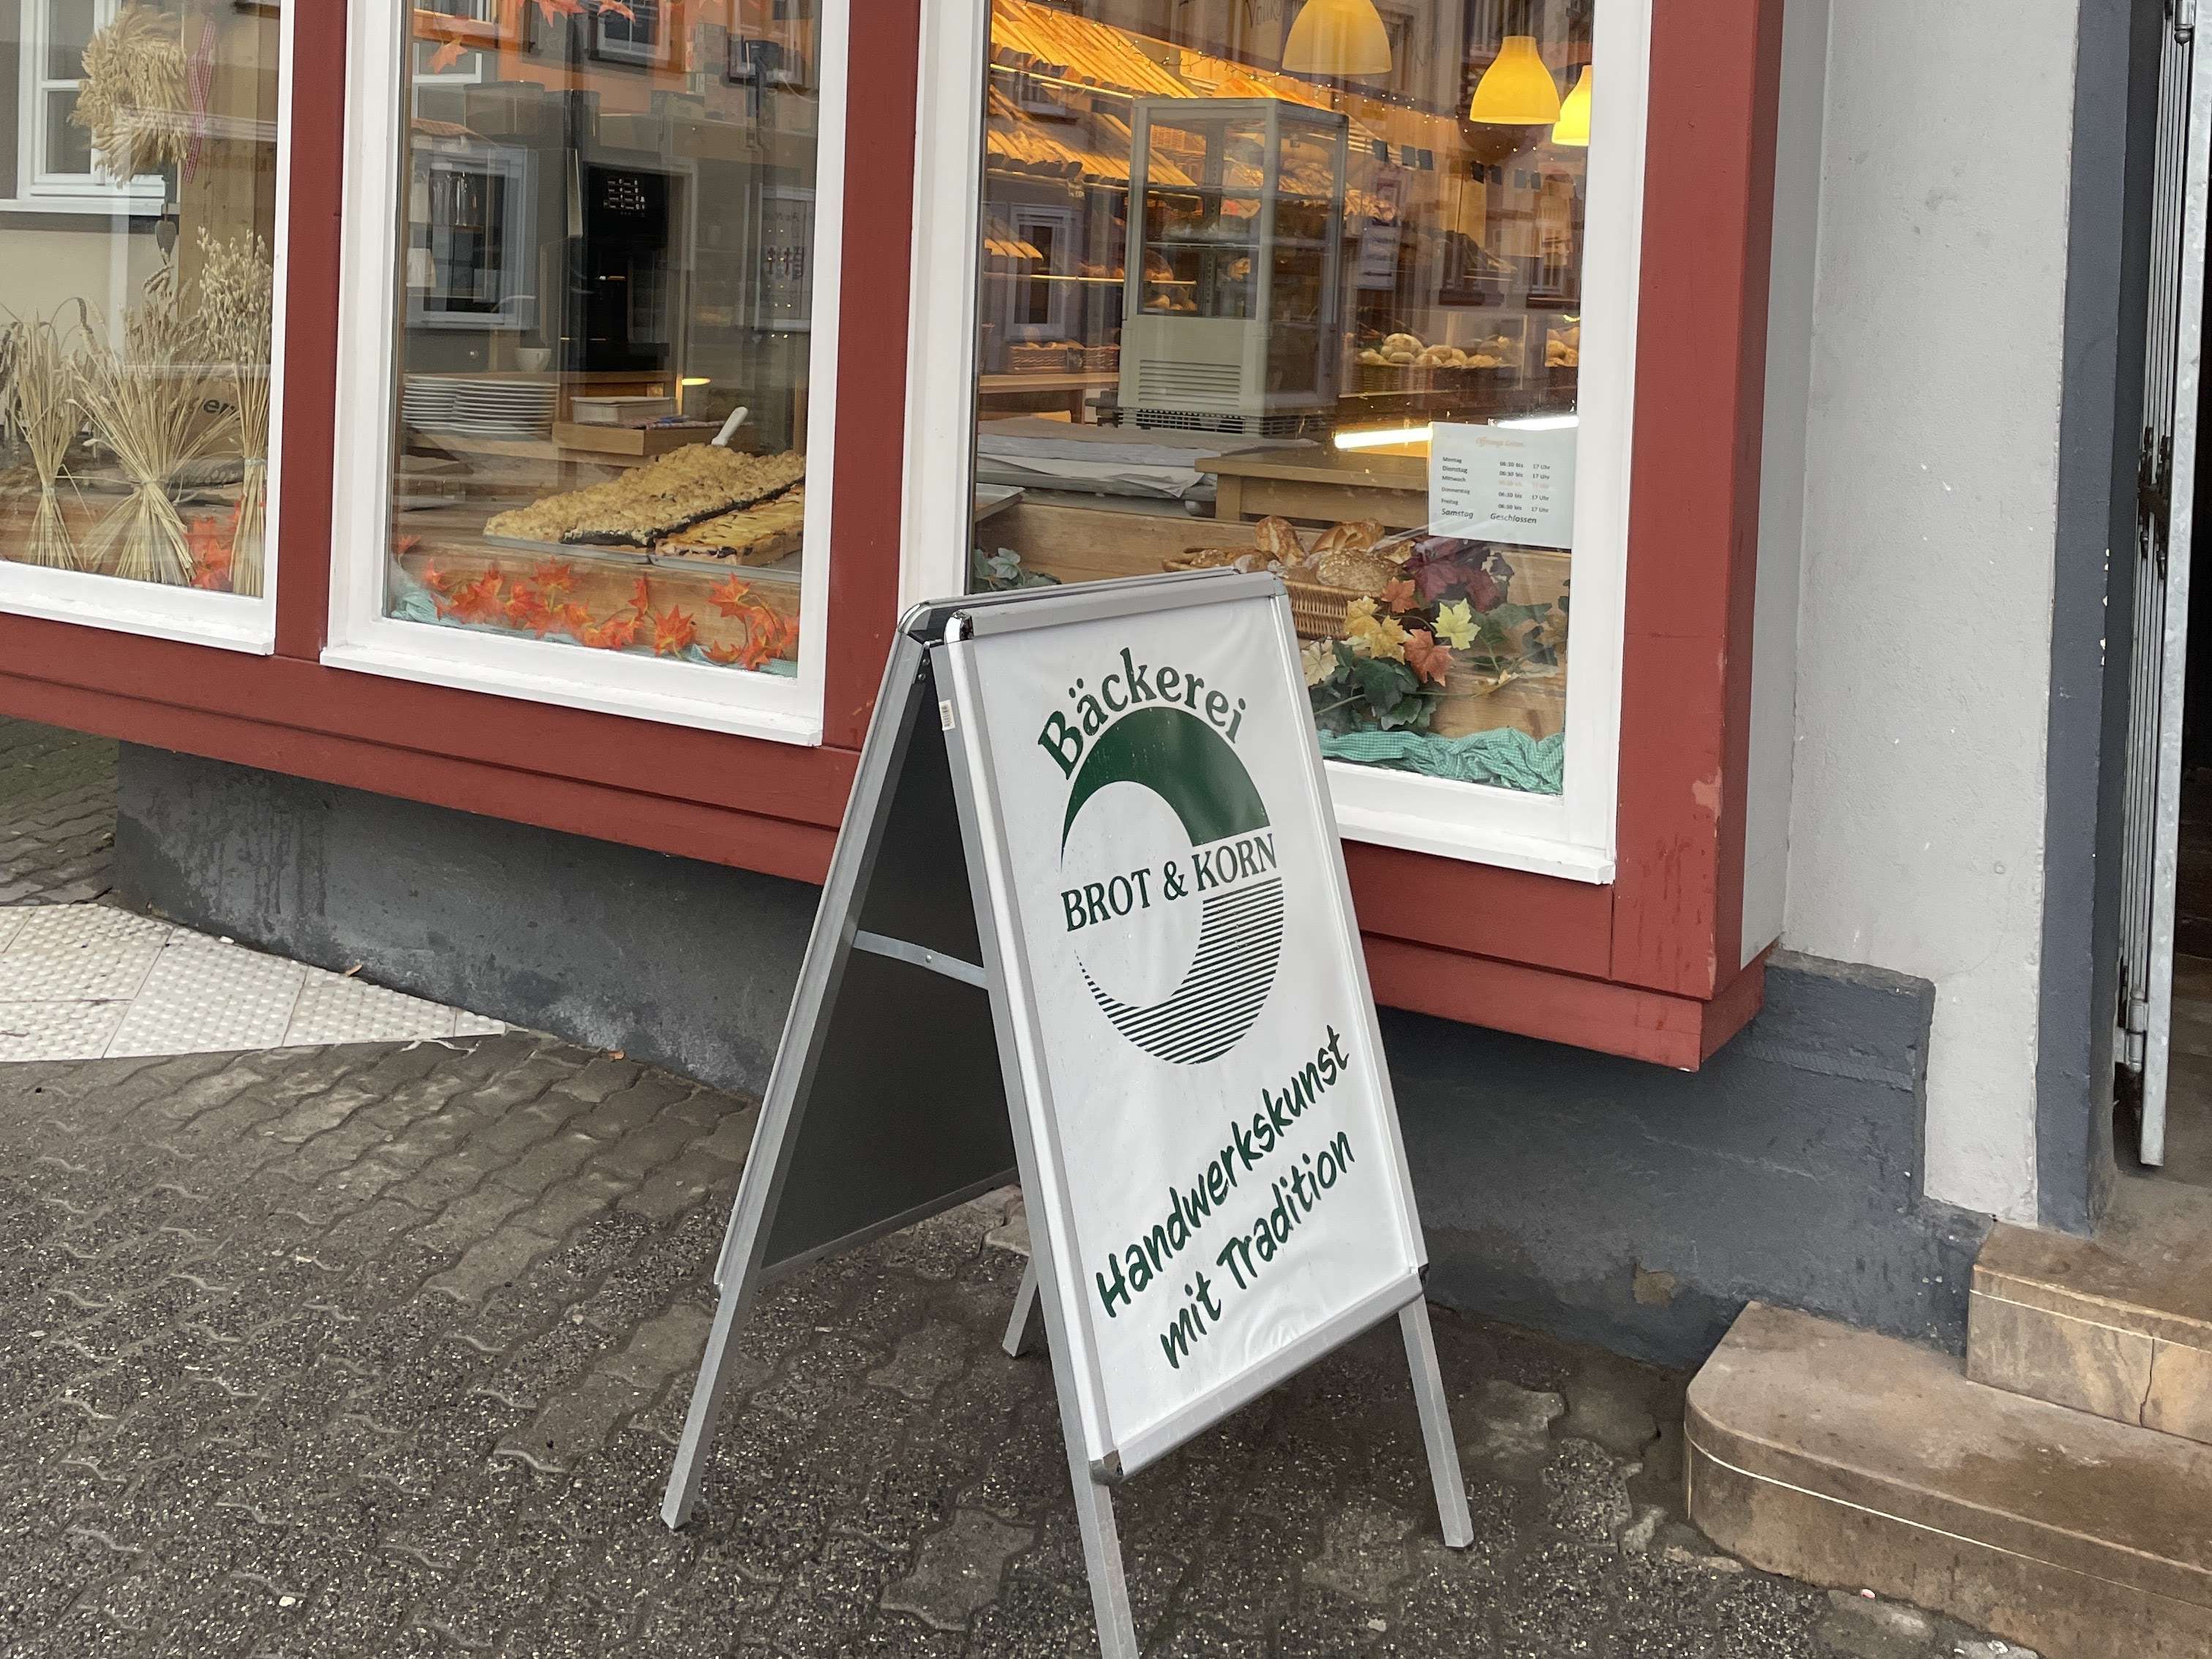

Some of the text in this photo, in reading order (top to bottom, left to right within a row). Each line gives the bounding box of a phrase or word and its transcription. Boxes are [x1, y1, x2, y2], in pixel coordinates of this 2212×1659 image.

[1441, 486, 1470, 494] Donnerstag
[1441, 508, 1537, 524] Samstag Geschlossen
[1442, 465, 1468, 474] Dienstag
[1037, 647, 1246, 780] Bäckerei
[1061, 832, 1277, 932] BROT & KORN
[1096, 1024, 1350, 1317] Handwerkskunst
[1160, 1132, 1355, 1369] mit Tradition
